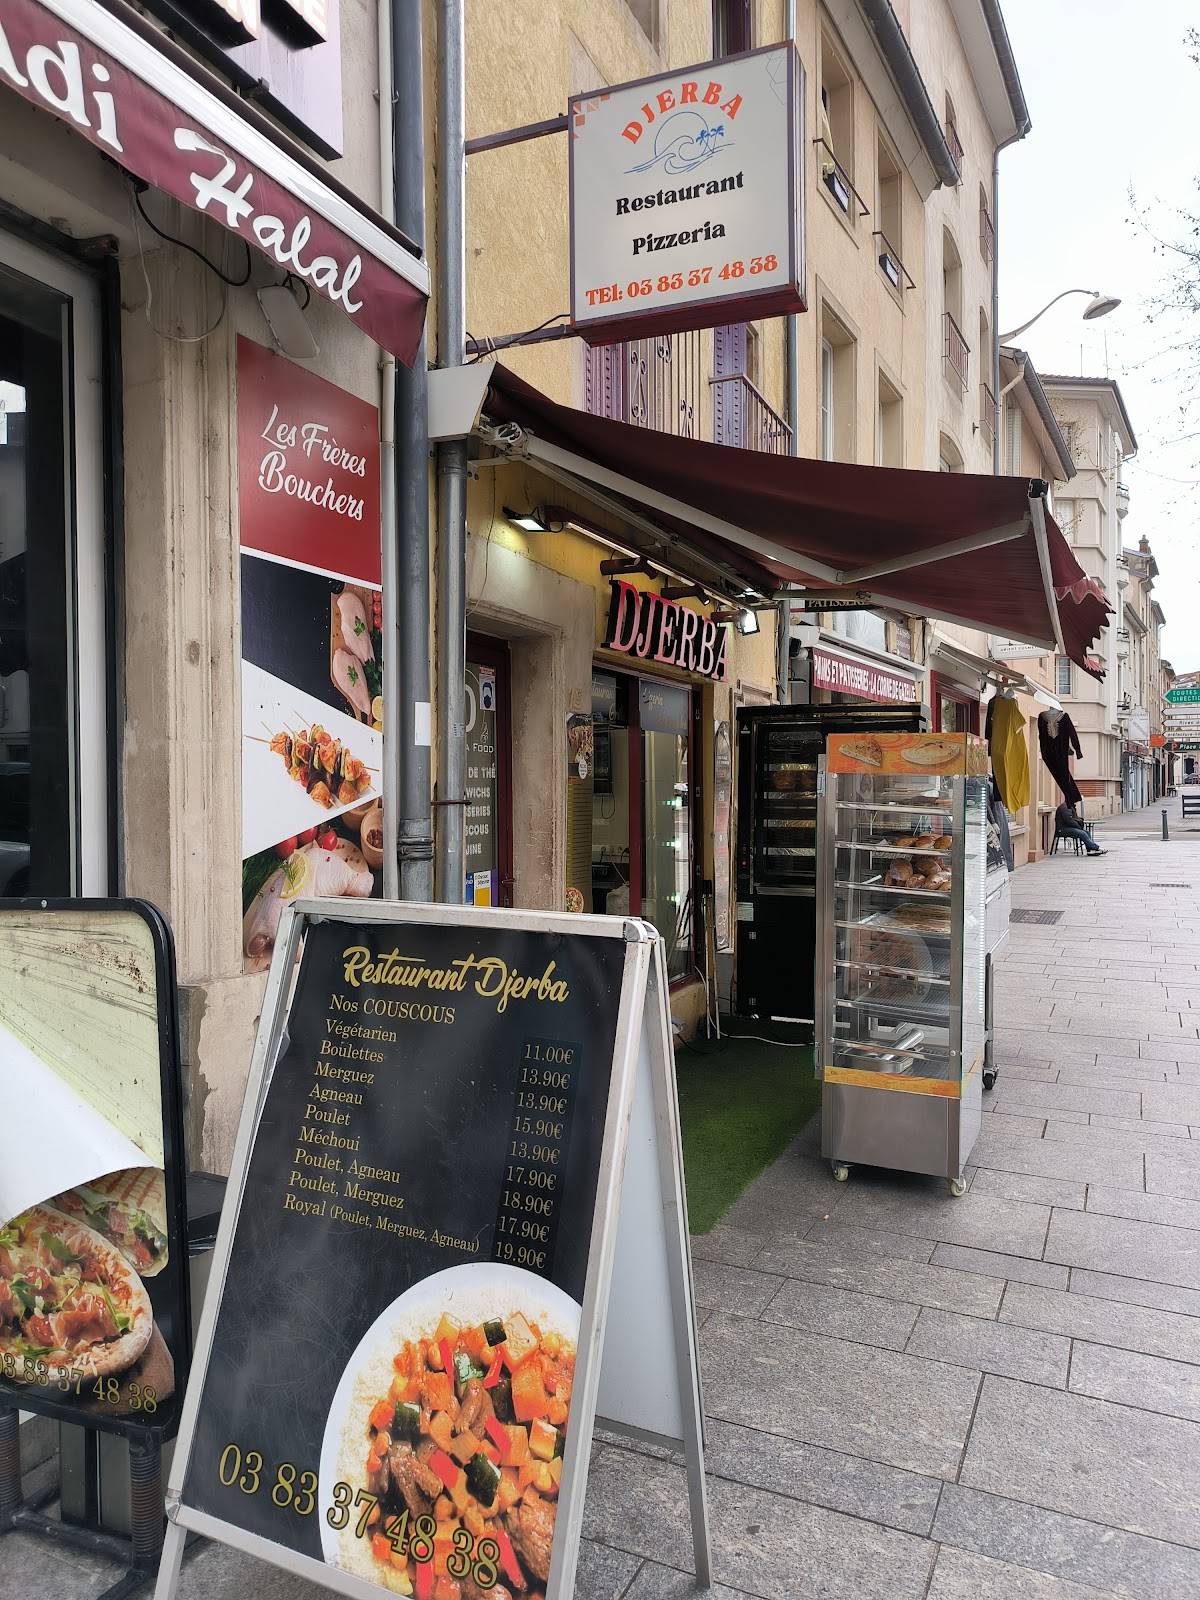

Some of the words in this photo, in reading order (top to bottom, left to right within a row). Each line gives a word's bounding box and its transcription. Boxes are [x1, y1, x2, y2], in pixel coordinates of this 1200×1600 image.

[621, 81, 743, 144] DJERBA
[615, 171, 744, 216] Restaurant
[174, 127, 364, 314] Halal
[632, 221, 726, 255] Pizzeria
[627, 281, 653, 299] 03
[657, 273, 684, 292] 83
[688, 266, 713, 285] 37
[718, 260, 745, 280] 48
[750, 255, 778, 275] 38
[261, 404, 298, 450] Les
[301, 423, 366, 477] Frères
[258, 451, 364, 521] Bouchers
[609, 579, 729, 683] DJERBA
[472, 742, 494, 753] FOOD
[468, 766, 479, 779] DE
[481, 762, 496, 779] THÉ
[342, 945, 468, 992] Restaurant
[474, 956, 570, 1014] Djerba
[329, 994, 358, 1013] Nos
[363, 998, 456, 1025] COUSCOUS
[326, 1018, 397, 1042] Végétarien
[320, 1039, 384, 1063] Boulettes
[524, 1043, 574, 1065] 11.00€
[314, 1060, 375, 1084] Merguez
[520, 1068, 571, 1089] 13.90€
[308, 1082, 363, 1105] Agneau
[517, 1091, 568, 1114] 13.90€
[303, 1103, 351, 1126] Poulet
[513, 1116, 563, 1140] 15.90€
[298, 1125, 360, 1151] Méchoui
[293, 1148, 344, 1173] Poulet,
[347, 1158, 401, 1184] Agneau
[509, 1141, 560, 1165] 13.90€
[288, 1170, 339, 1196] Poulet,
[343, 1180, 405, 1209] Merguez
[506, 1165, 557, 1191] 17.90€
[502, 1190, 553, 1217] 18.90€
[283, 1193, 326, 1217] Royal
[330, 1206, 373, 1228] (Poulet,
[376, 1215, 427, 1243] Merguez,
[430, 1228, 480, 1254] Agneau)
[499, 1215, 550, 1243] 17.90€
[495, 1241, 546, 1269] 19.90€
[23, 1357, 50, 1386] 83
[57, 1366, 84, 1395] 37
[93, 1375, 120, 1404] 48
[128, 1382, 157, 1413] 38
[219, 1444, 263, 1494] 03
[271, 1463, 318, 1515] 83
[326, 1481, 378, 1538] 37
[385, 1509, 437, 1563] 48
[446, 1527, 500, 1589] 38
